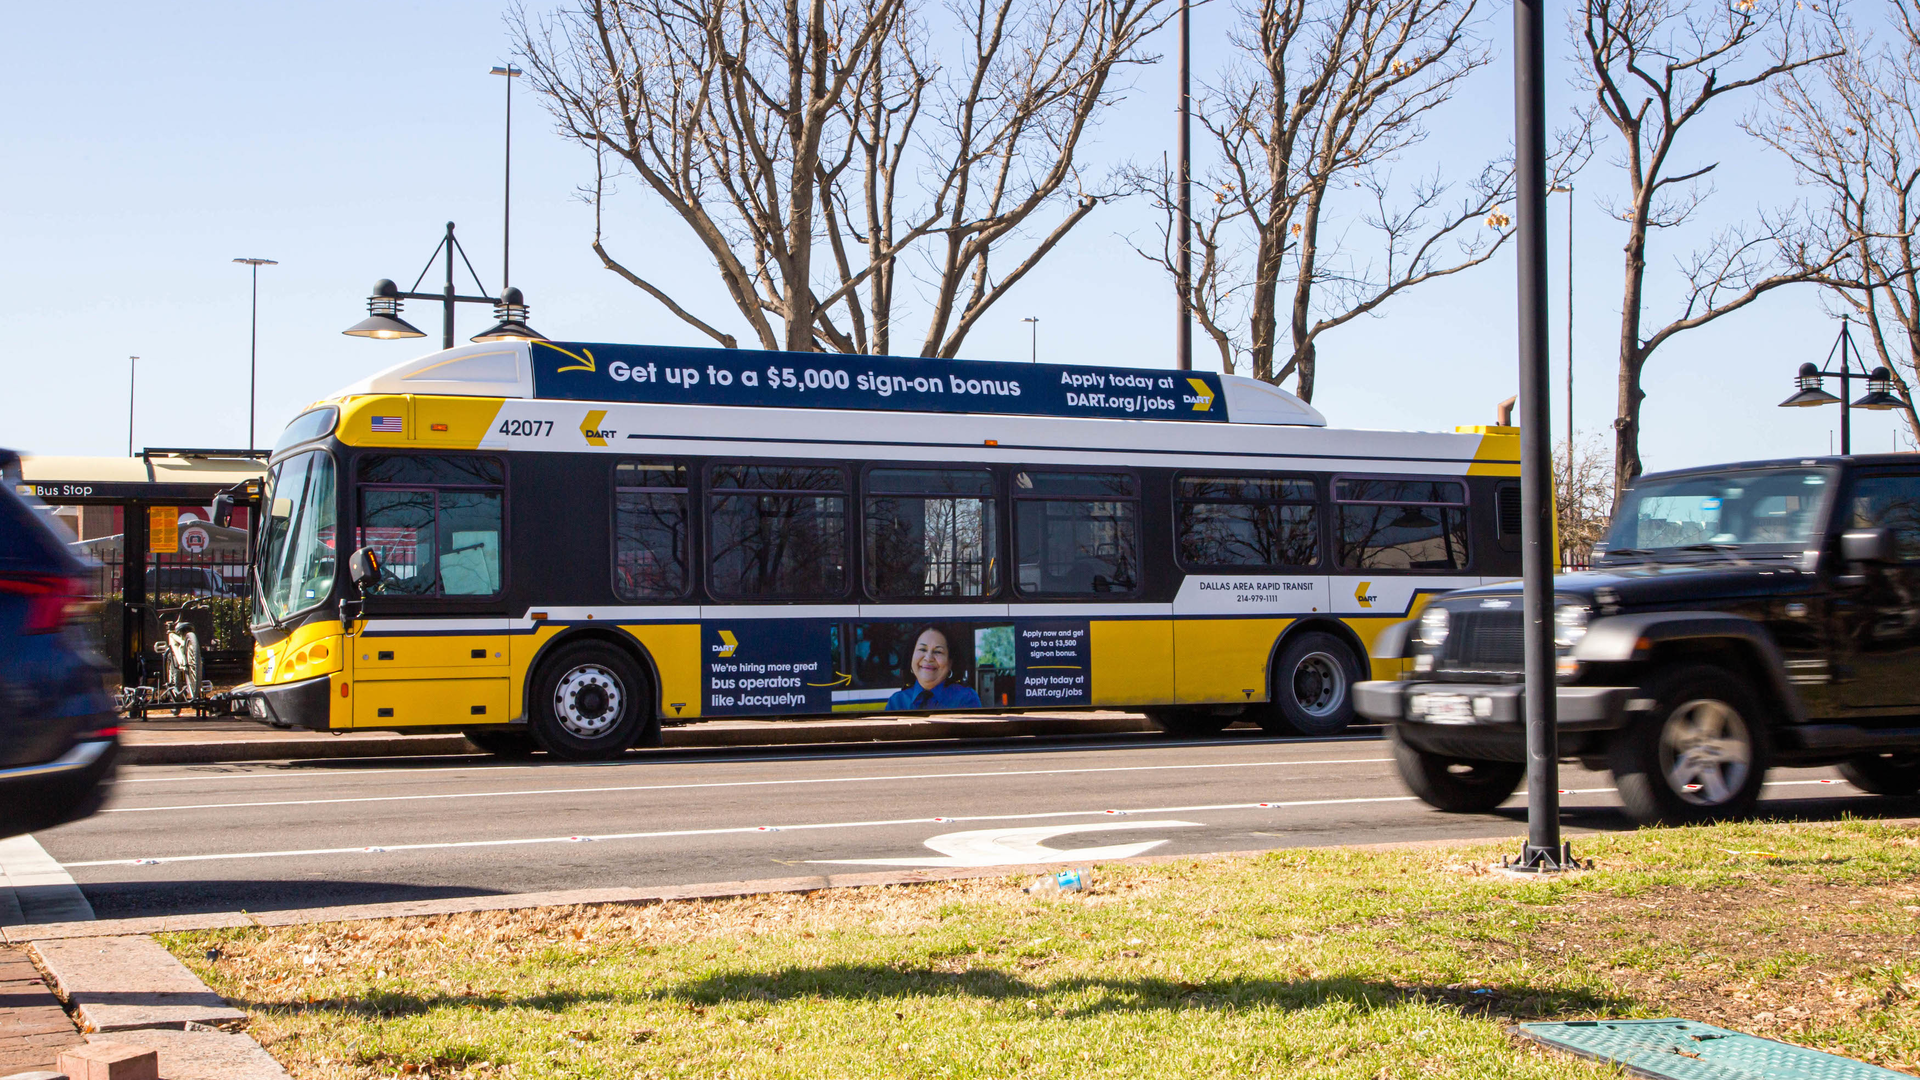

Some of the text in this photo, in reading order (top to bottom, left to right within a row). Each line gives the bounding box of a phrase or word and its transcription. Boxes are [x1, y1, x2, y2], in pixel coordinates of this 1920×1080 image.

[608, 361, 1021, 396] Get up to a $5,000 sign-on bonus
[1061, 372, 1174, 390] Apply today at
[1066, 393, 1176, 412] DART.org/jobs
[499, 419, 554, 437] 42077
[37, 485, 93, 497] Bus Stop
[1200, 582, 1313, 591] DALLAS AREA RAPID TRANSIT
[1237, 595, 1278, 603] 214-979-1111
[1022, 630, 1042, 638] Apply
[1072, 630, 1084, 638] get
[1055, 639, 1077, 647] $3,500
[1030, 650, 1054, 659] sign-on
[711, 662, 818, 674] We're hiring more great
[711, 676, 801, 691] bus operators
[1024, 676, 1084, 686] Apply today at
[1025, 688, 1083, 698] DART.org/jobs
[711, 693, 806, 707] like Jacquelyn
